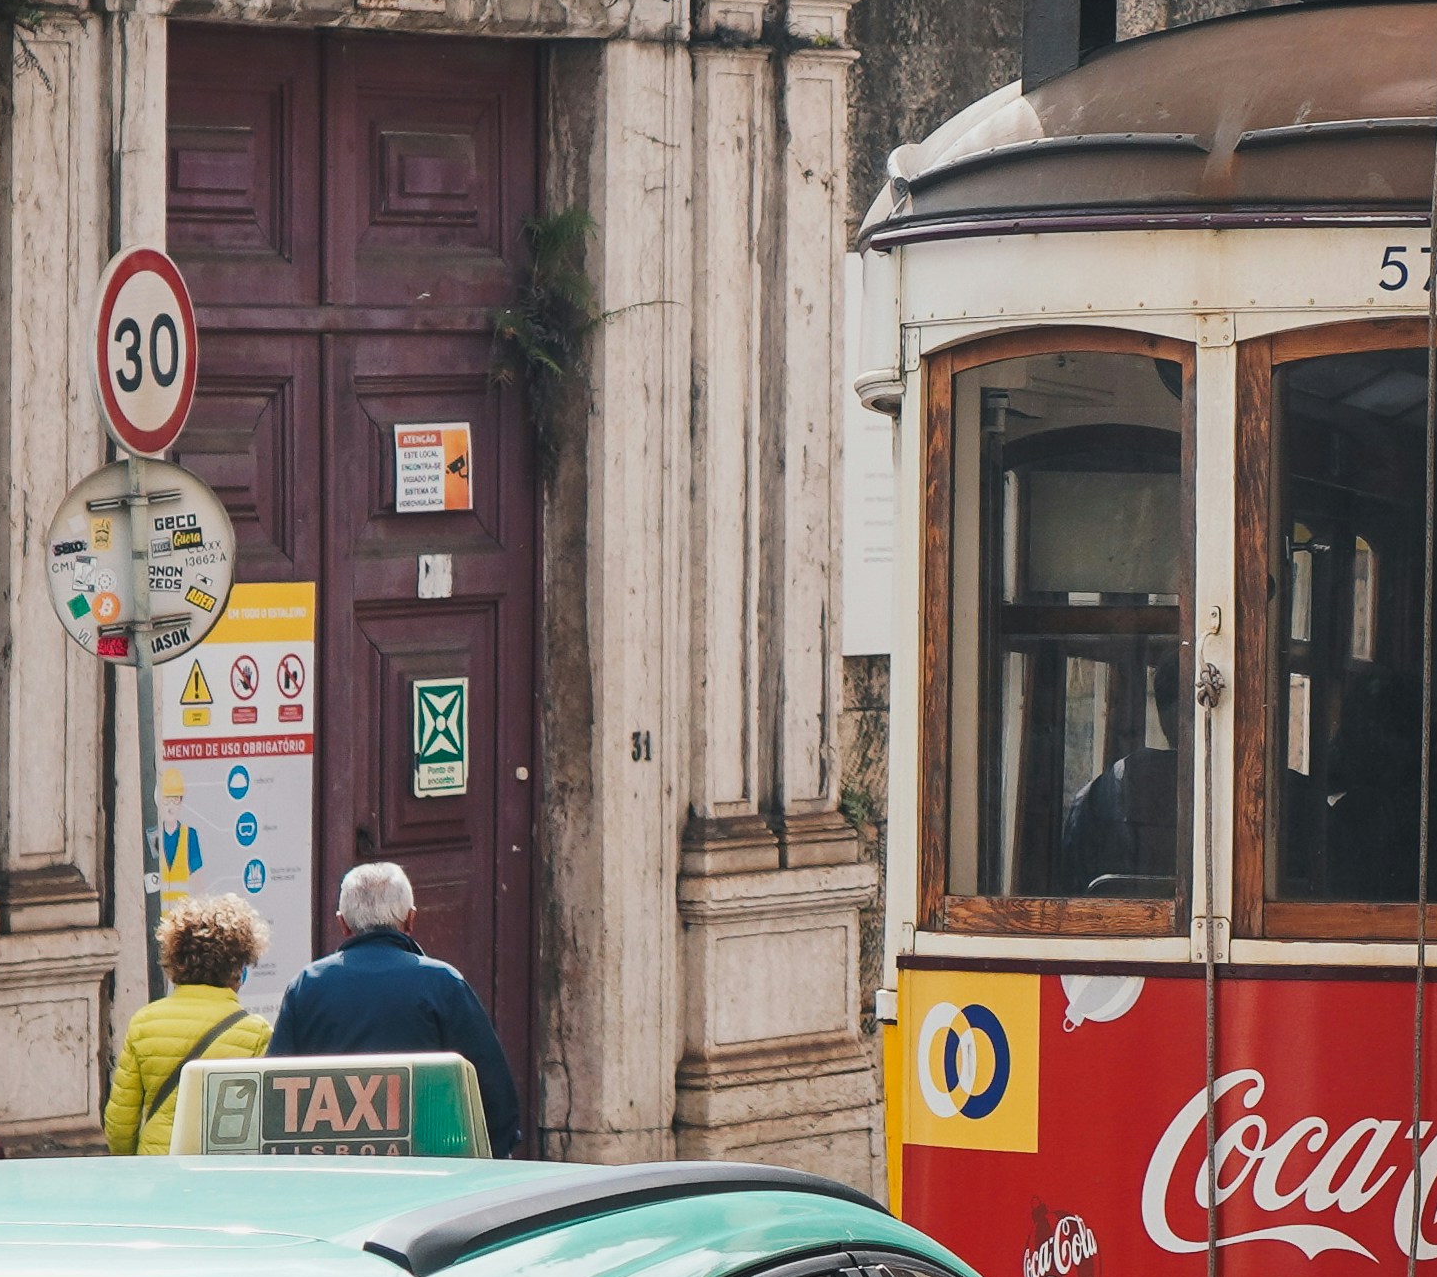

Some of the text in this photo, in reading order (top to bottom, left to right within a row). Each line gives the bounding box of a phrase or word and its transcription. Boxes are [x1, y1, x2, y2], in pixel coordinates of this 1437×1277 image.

[114, 312, 179, 393] 30
[404, 450, 439, 459] ESTE LOCAL
[428, 474, 440, 482] POR
[205, 743, 218, 757] DE
[220, 742, 239, 755] USO
[242, 738, 305, 754] OBRIGATÓRIO
[272, 1074, 401, 1133] TAXI
